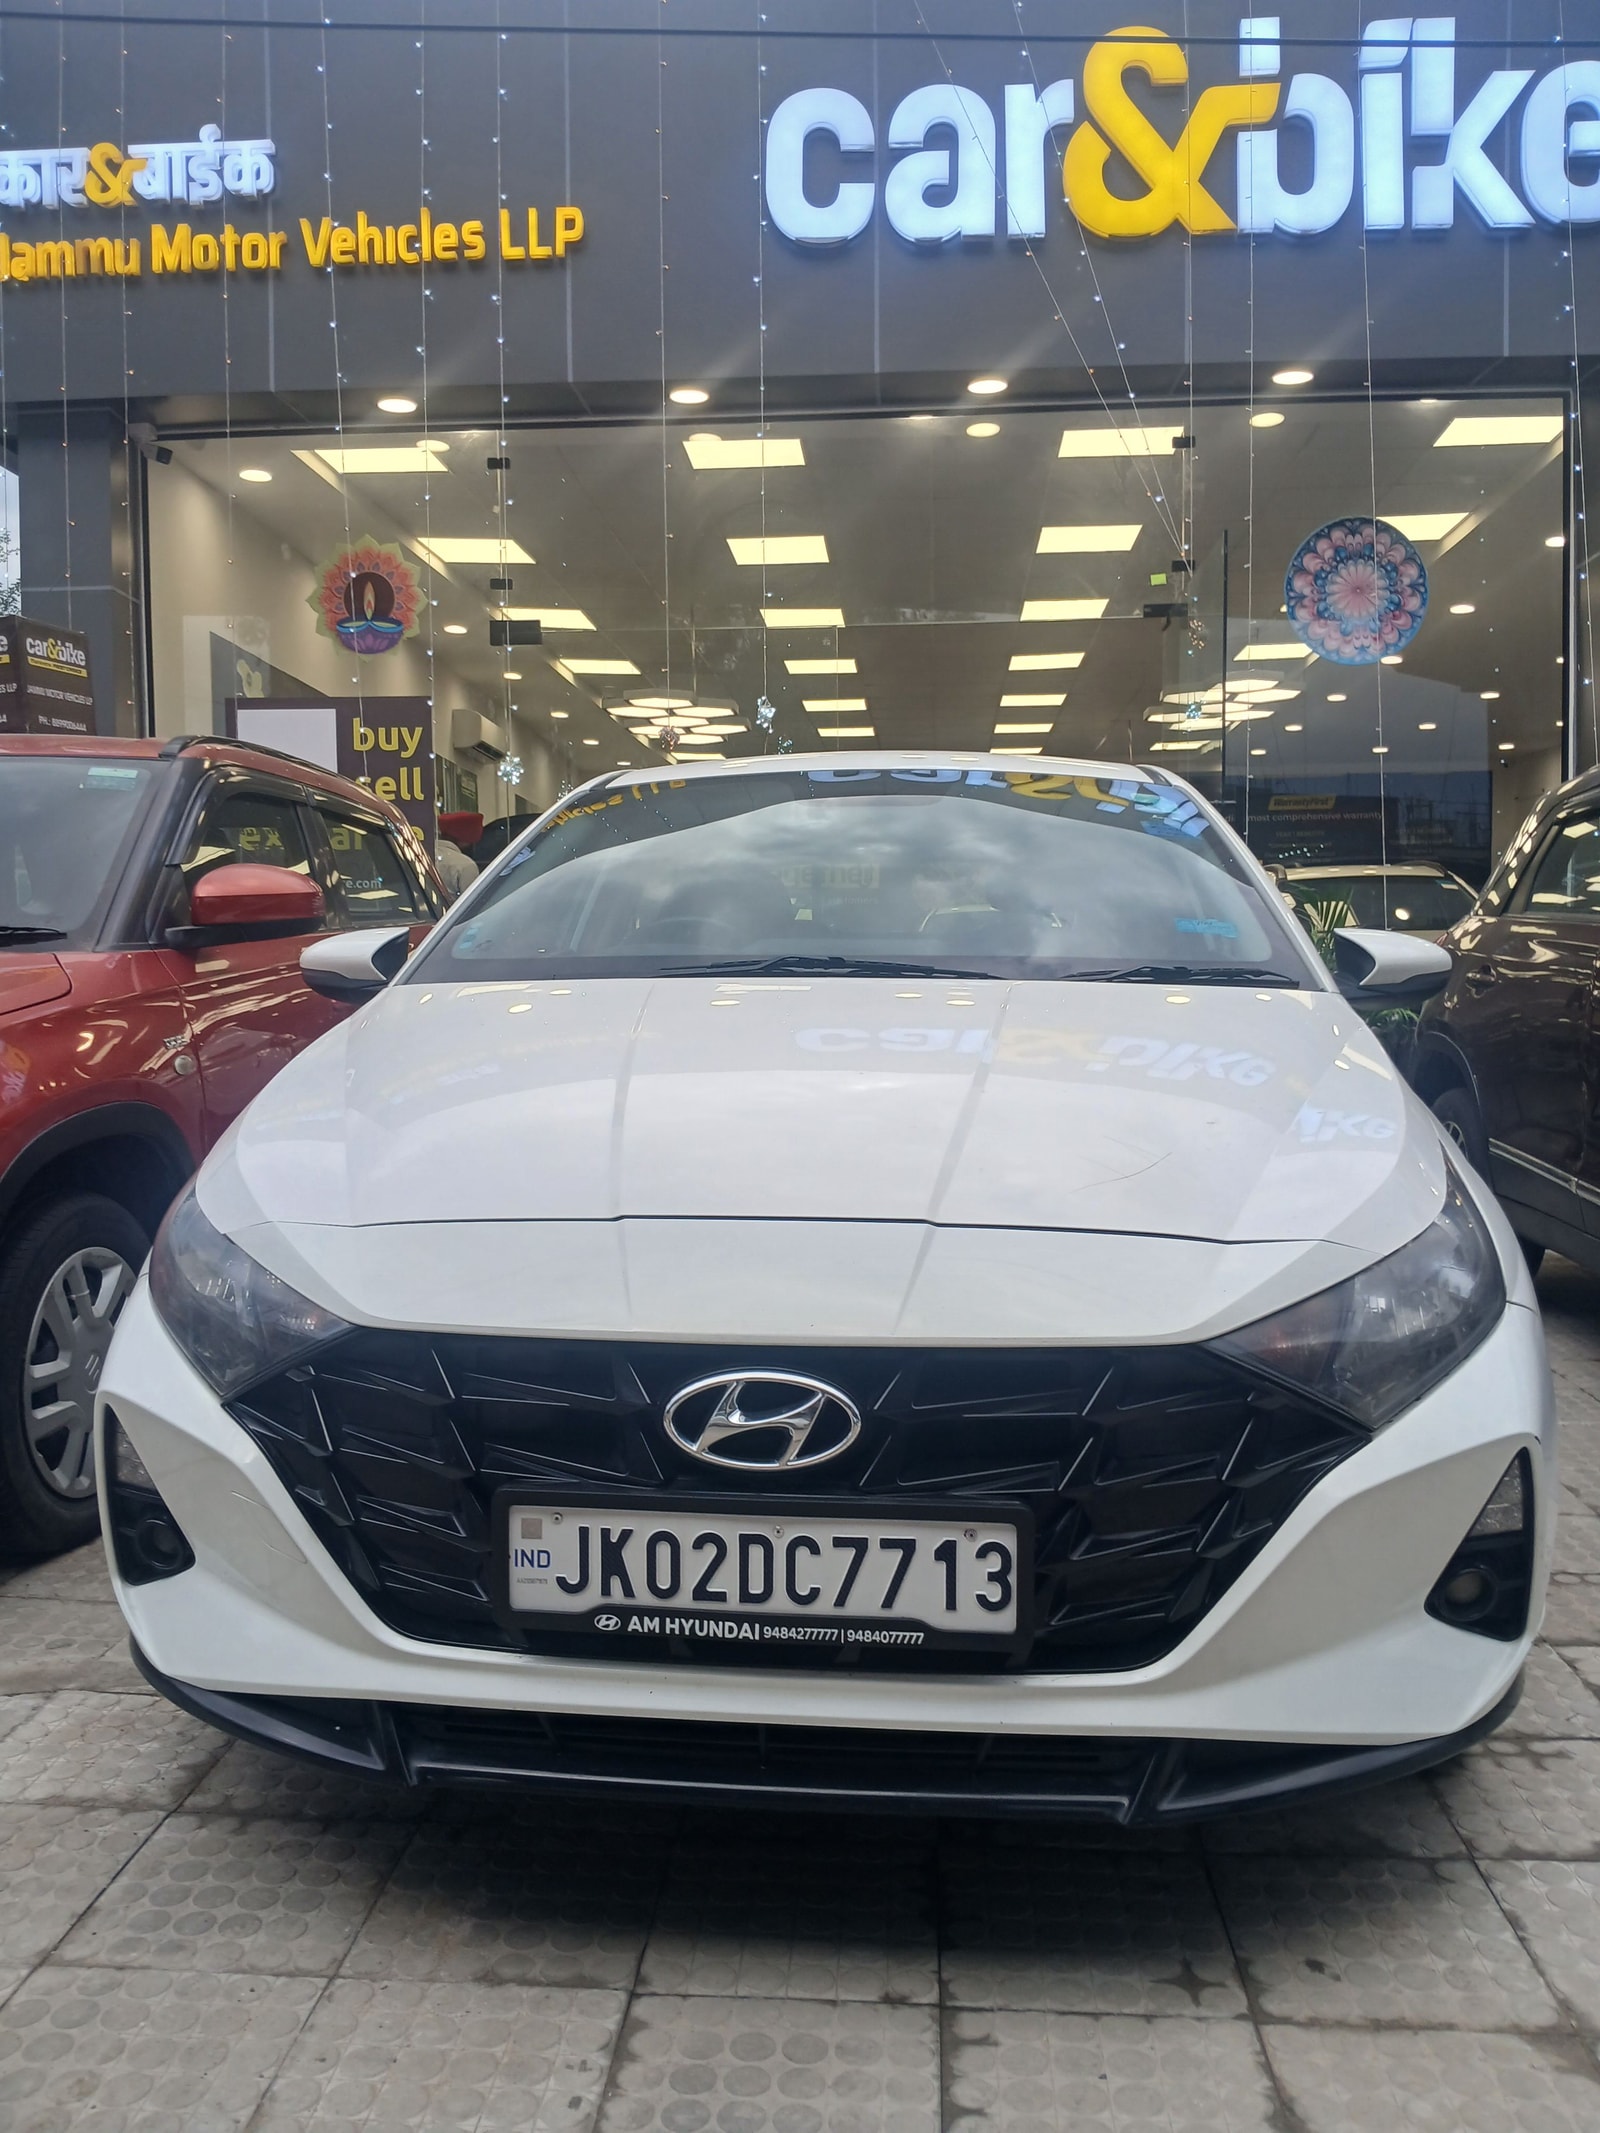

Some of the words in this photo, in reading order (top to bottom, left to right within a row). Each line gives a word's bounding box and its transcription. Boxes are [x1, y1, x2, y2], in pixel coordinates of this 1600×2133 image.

[765, 17, 1600, 244] car&bike
[151, 223, 288, 274] Motor
[299, 207, 486, 268] Vehicles
[500, 206, 585, 261] LLP
[26, 637, 86, 667] car&bike
[352, 717, 423, 759] buy
[1272, 812, 1341, 822] comprehensive
[514, 1548, 551, 1568] IND
[555, 1526, 1012, 1612] JK02DC7713
[627, 1615, 660, 1634] AM
[665, 1617, 760, 1641] HYUNDAI
